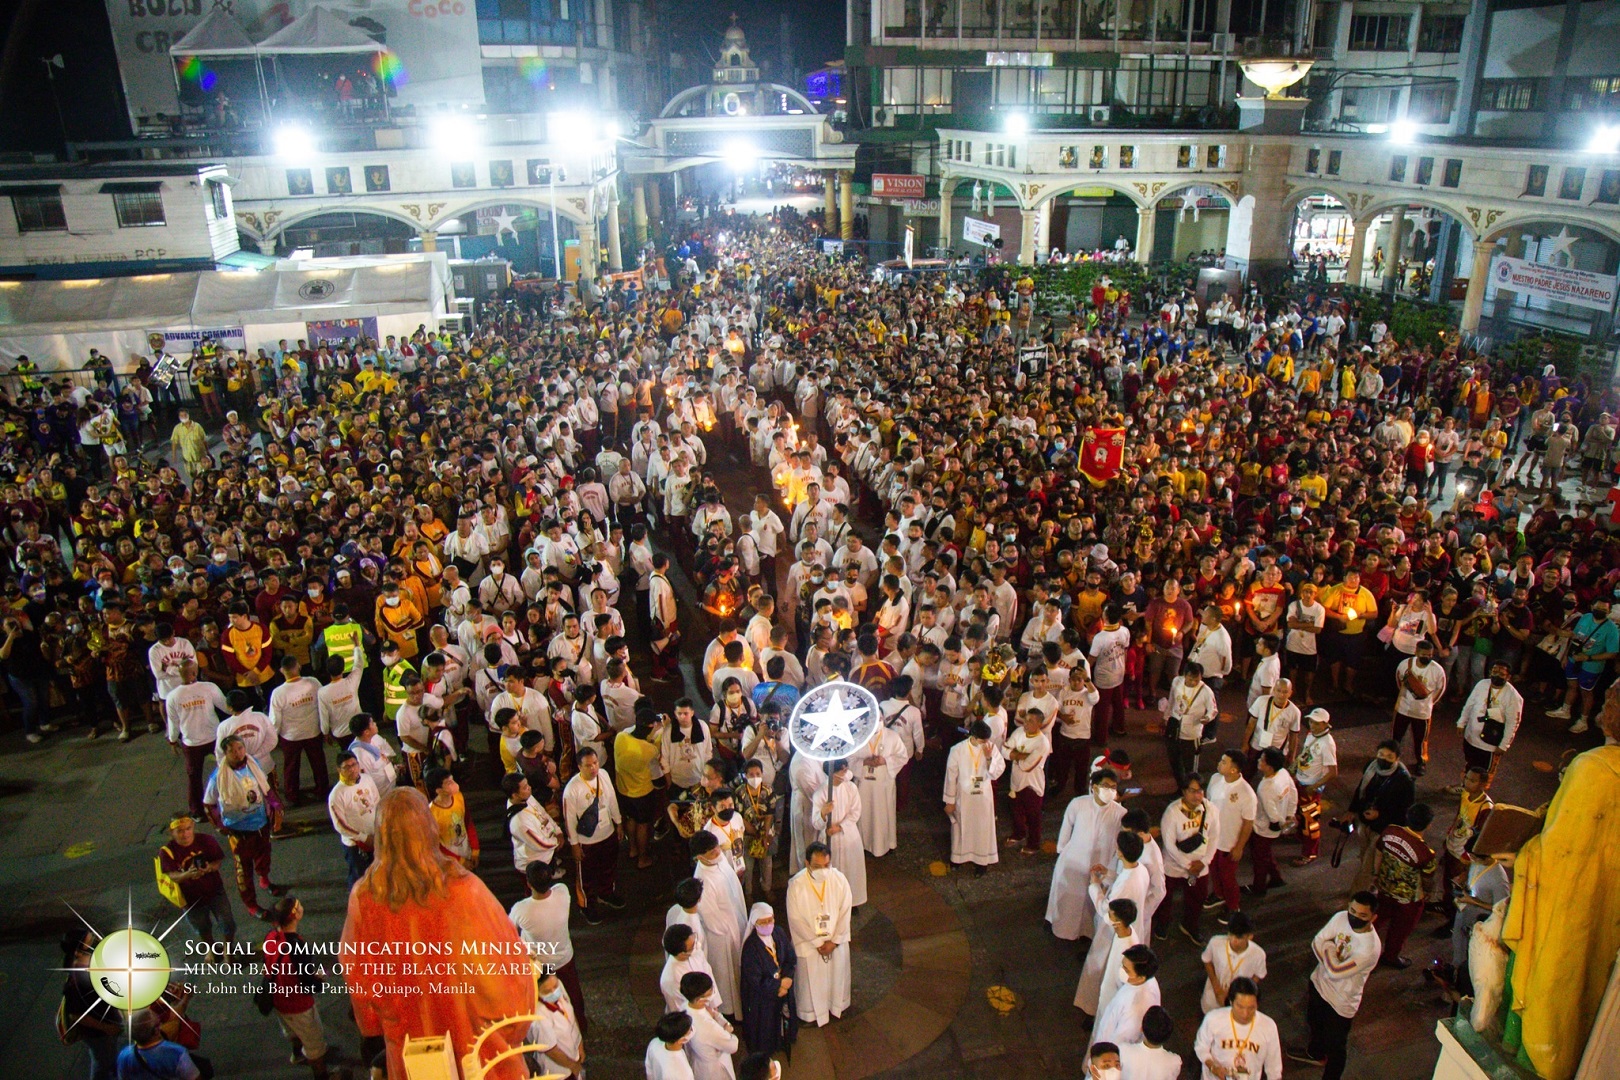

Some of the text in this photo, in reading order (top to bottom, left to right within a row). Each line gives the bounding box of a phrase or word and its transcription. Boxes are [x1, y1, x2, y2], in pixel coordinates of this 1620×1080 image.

[886, 179, 923, 187] VISION
[1512, 273, 1534, 285] NUESTRO
[1534, 277, 1552, 289] PADRE
[1553, 280, 1571, 291] JESUS
[1571, 285, 1612, 300] NAZARENO
[164, 328, 243, 341] ADVANCE COMMAND
[1221, 1039, 1260, 1054] HDN
